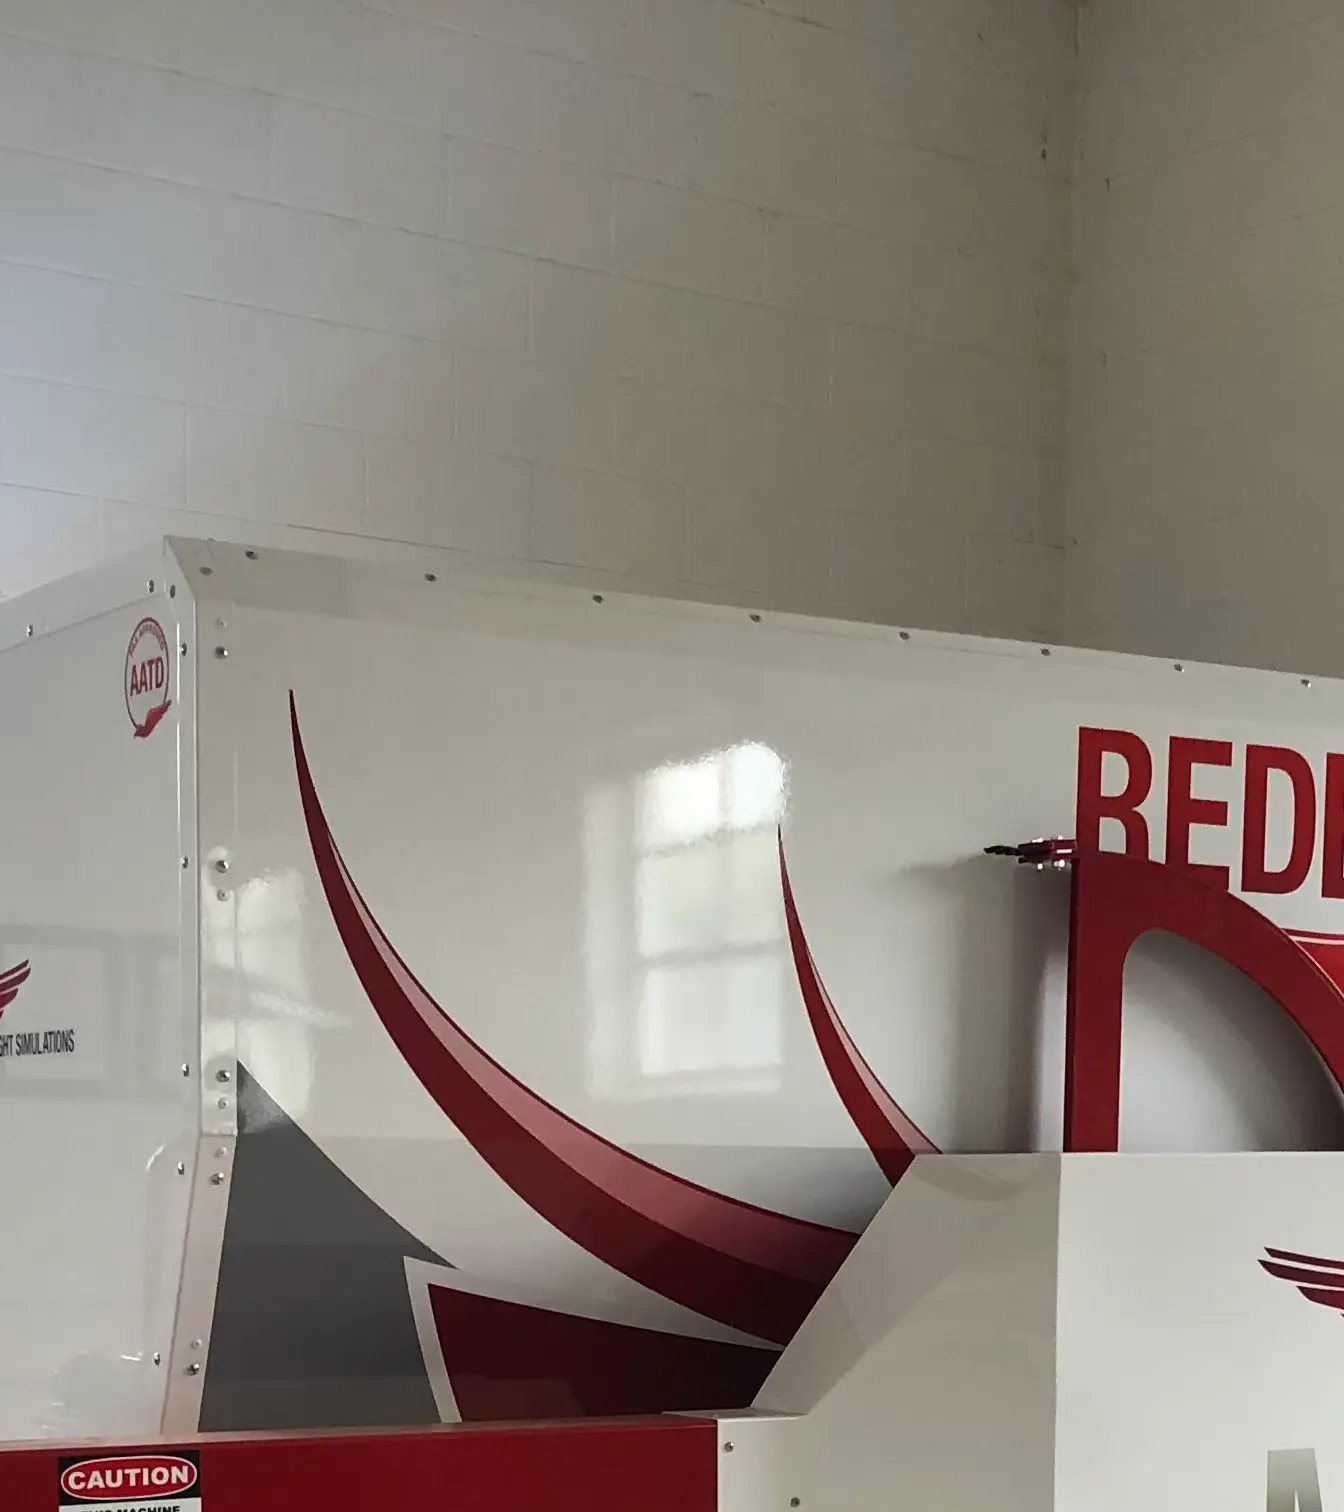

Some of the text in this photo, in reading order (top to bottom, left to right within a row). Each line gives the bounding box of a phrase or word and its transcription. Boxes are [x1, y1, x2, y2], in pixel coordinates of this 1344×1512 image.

[130, 657, 164, 696] AATD
[15, 1029, 74, 1056] SIMULATIONS
[68, 1465, 189, 1490] CAUTION
